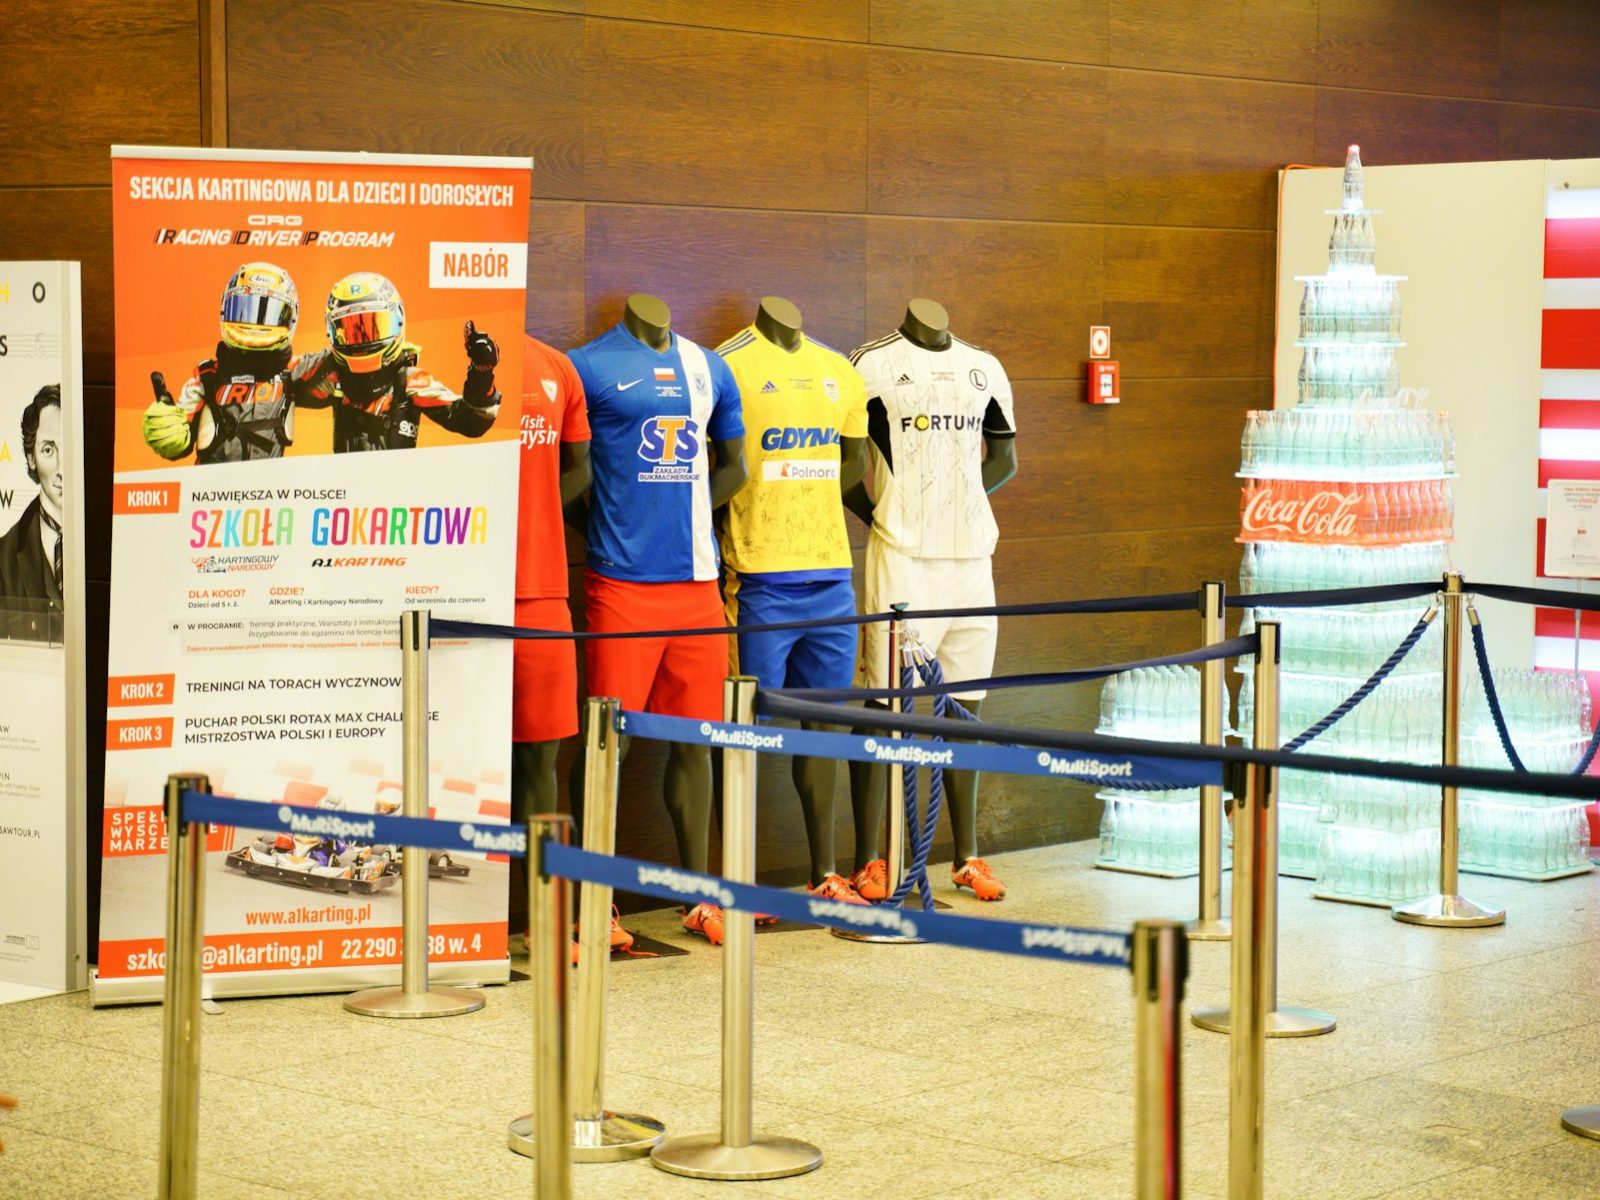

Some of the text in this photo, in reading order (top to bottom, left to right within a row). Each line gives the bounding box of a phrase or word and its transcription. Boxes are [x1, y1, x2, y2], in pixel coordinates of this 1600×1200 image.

[129, 176, 514, 207] SEKCJA KARTINGOWA DLA DZIECI I DOROSŁYCH
[158, 228, 395, 247] RACING DRIVER PROGRAM
[443, 248, 509, 278] NABÓR
[637, 415, 699, 465] STS
[127, 491, 161, 507] KROK
[192, 489, 347, 504] NAJWIĘKSZA W POLSCE!
[190, 506, 488, 549] SZKOŁA GOKARTOWA
[311, 556, 407, 568] A1KARTING
[188, 588, 246, 599] DLA KOGO?
[269, 587, 305, 596] GDZIE?
[405, 586, 440, 595] KIEDY?
[188, 601, 210, 609] Dzieci
[308, 598, 347, 607] Kartingowy
[348, 597, 384, 606] Narodowy
[447, 596, 457, 604] do
[197, 622, 245, 630] PROGRAMIE:
[249, 620, 275, 629] Treningi
[121, 682, 164, 699] KROK 2
[186, 677, 402, 693] TRENINGI NA TORACH WYCZYNOW
[185, 716, 238, 728] PUCHAR
[241, 714, 286, 726] POLSKI
[290, 713, 332, 725] ROTAX
[335, 712, 363, 723] MAX
[119, 725, 163, 742] KROK 3
[184, 727, 386, 744] MISTRZOSTWA POLSKI I EUROPY
[710, 730, 1132, 778] MultiSport MultiSport MultiSport
[290, 813, 527, 852] MultiSport MultiS
[110, 837, 169, 852] MARZE
[245, 904, 371, 925] www.a1karting.pl
[341, 938, 362, 959] 22
[364, 937, 397, 958] 290
[448, 937, 468, 954] w.
[471, 933, 482, 953] 4
